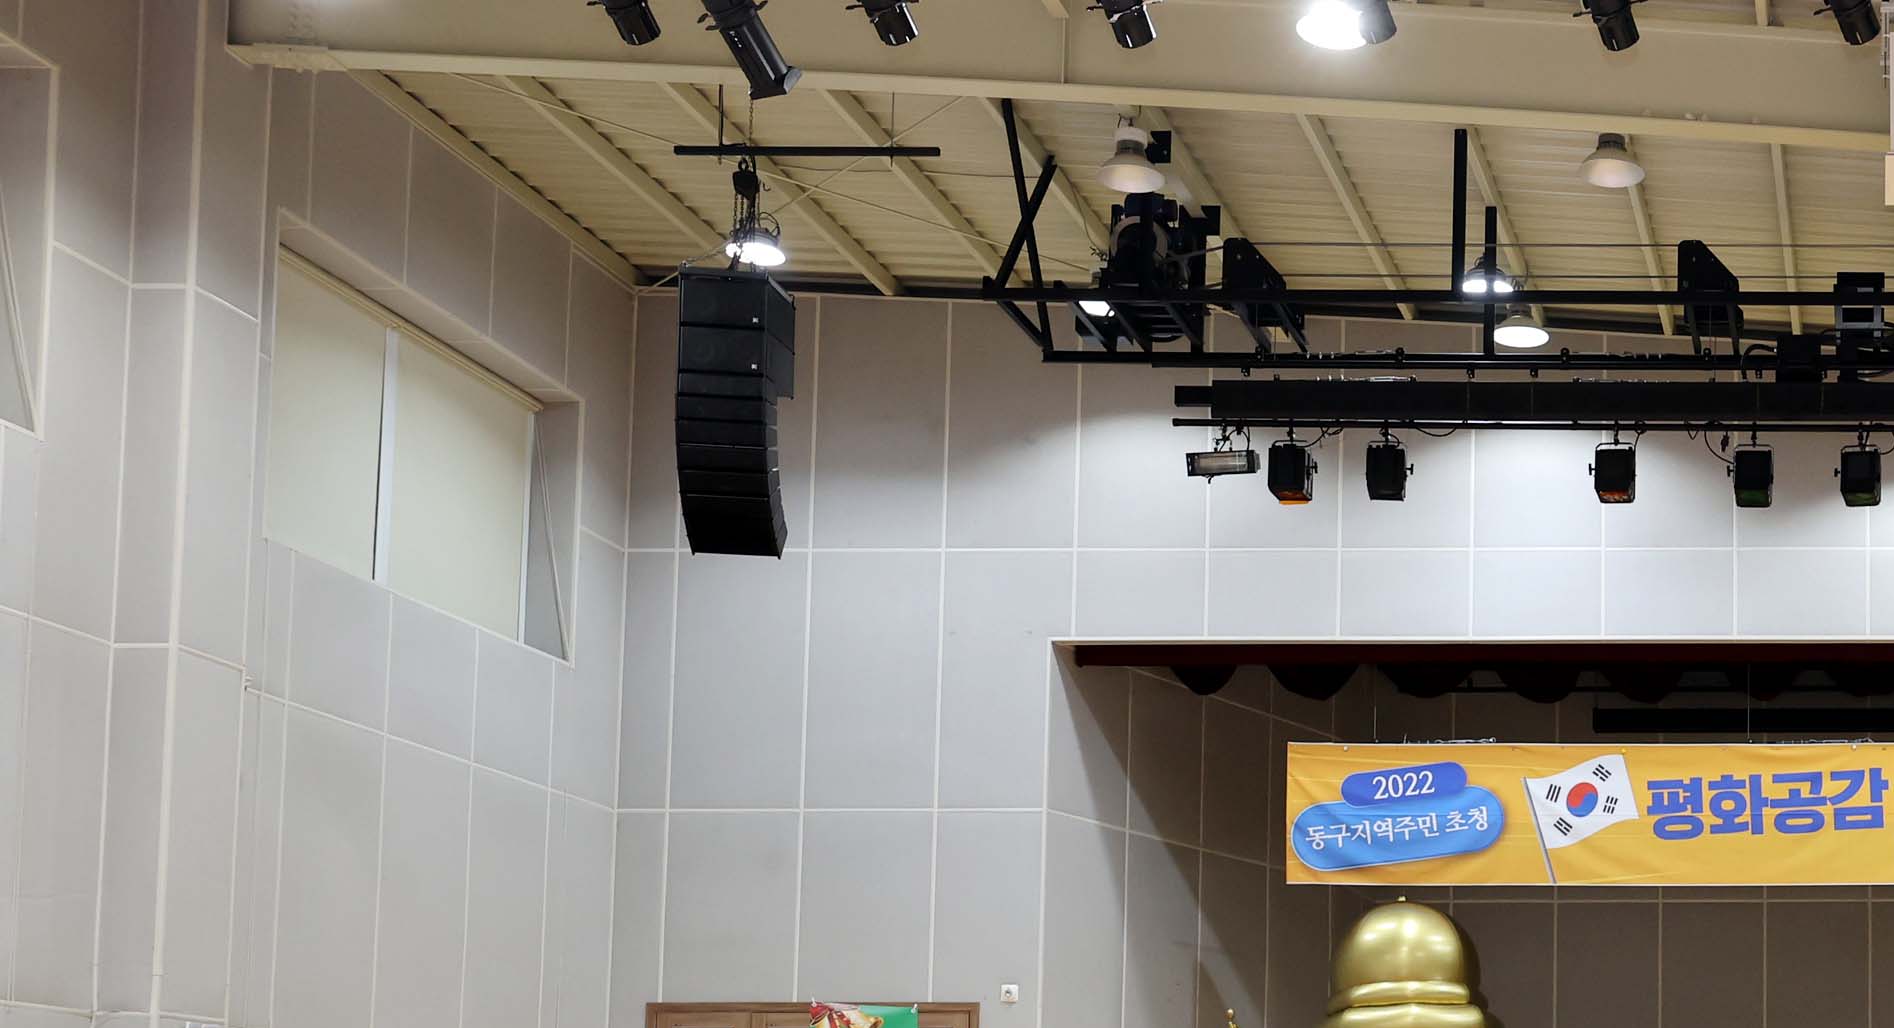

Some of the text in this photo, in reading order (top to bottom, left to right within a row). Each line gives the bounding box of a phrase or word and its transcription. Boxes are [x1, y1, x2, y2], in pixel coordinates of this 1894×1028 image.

[1372, 770, 1436, 800] 2022
[1646, 767, 1890, 841] 평화공감
[1305, 806, 1489, 850] 동구지역주민 초청
